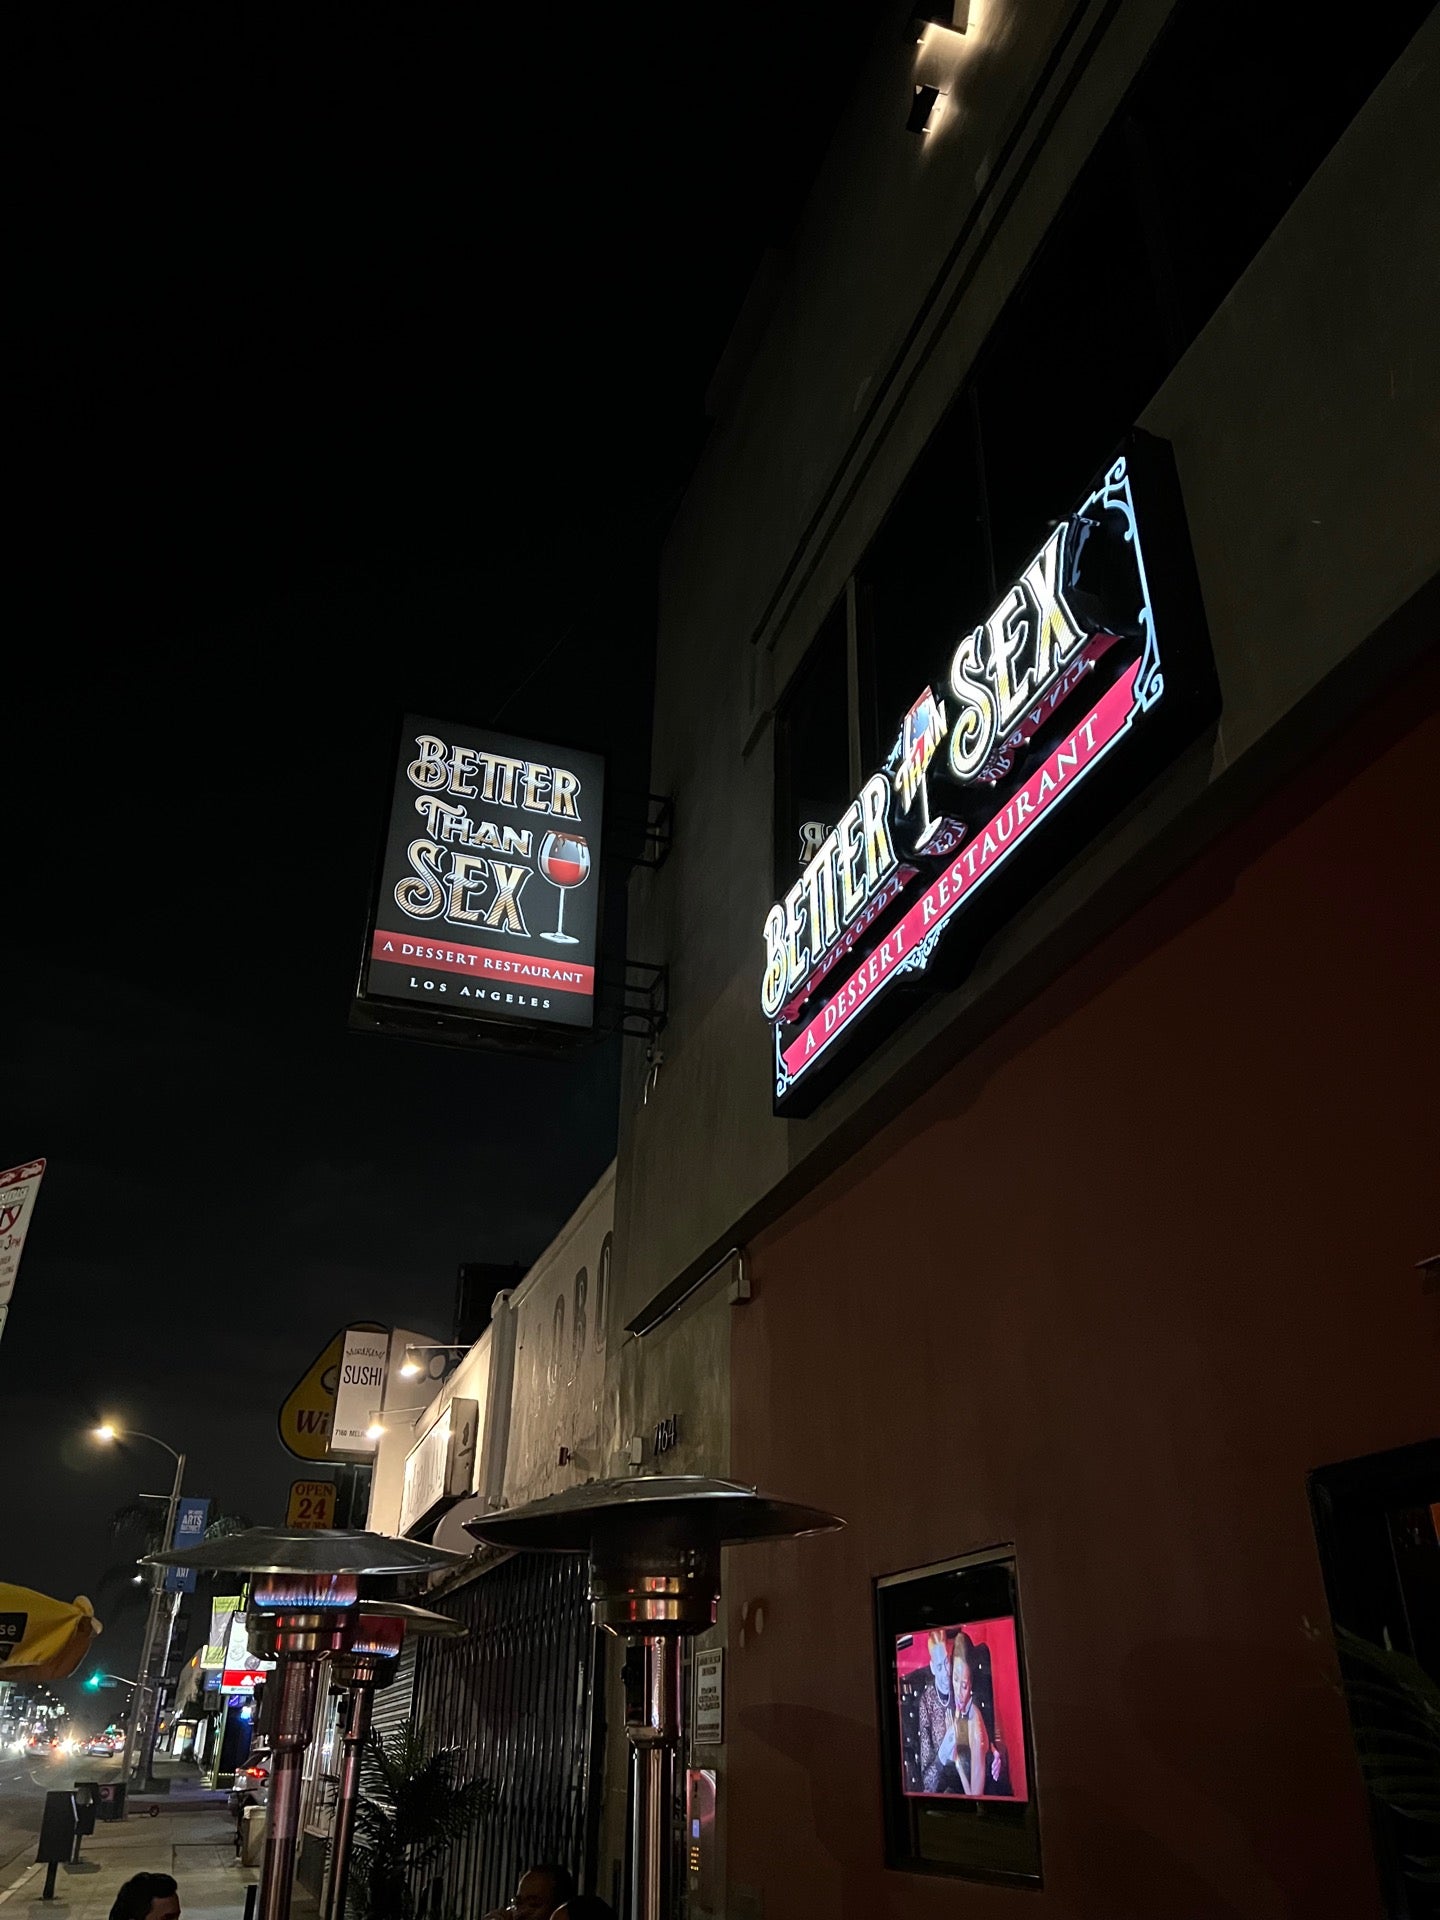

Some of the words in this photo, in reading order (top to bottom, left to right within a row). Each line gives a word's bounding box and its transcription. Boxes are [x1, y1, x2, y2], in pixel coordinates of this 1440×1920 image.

[406, 734, 582, 822] BETTER
[761, 771, 898, 1021] BETTER
[895, 699, 949, 815] THAN
[946, 521, 1088, 784] SEX
[414, 795, 533, 857] THAN
[394, 838, 534, 938] SEX
[804, 1030, 816, 1054] A
[823, 924, 907, 1036] DESSERT
[921, 713, 1101, 925] RESTAURANT
[382, 940, 395, 953] A
[402, 943, 478, 966] DESSERT
[483, 958, 584, 984] RESTAURANT
[410, 977, 448, 993] LOS
[460, 986, 551, 1010] ANGELES
[343, 1364, 383, 1387] SUSHI
[296, 1410, 329, 1435] Wi
[652, 1413, 677, 1456] 7164
[294, 1484, 333, 1497] OPEN
[297, 1498, 327, 1520] 24
[181, 1513, 203, 1526] ARTS
